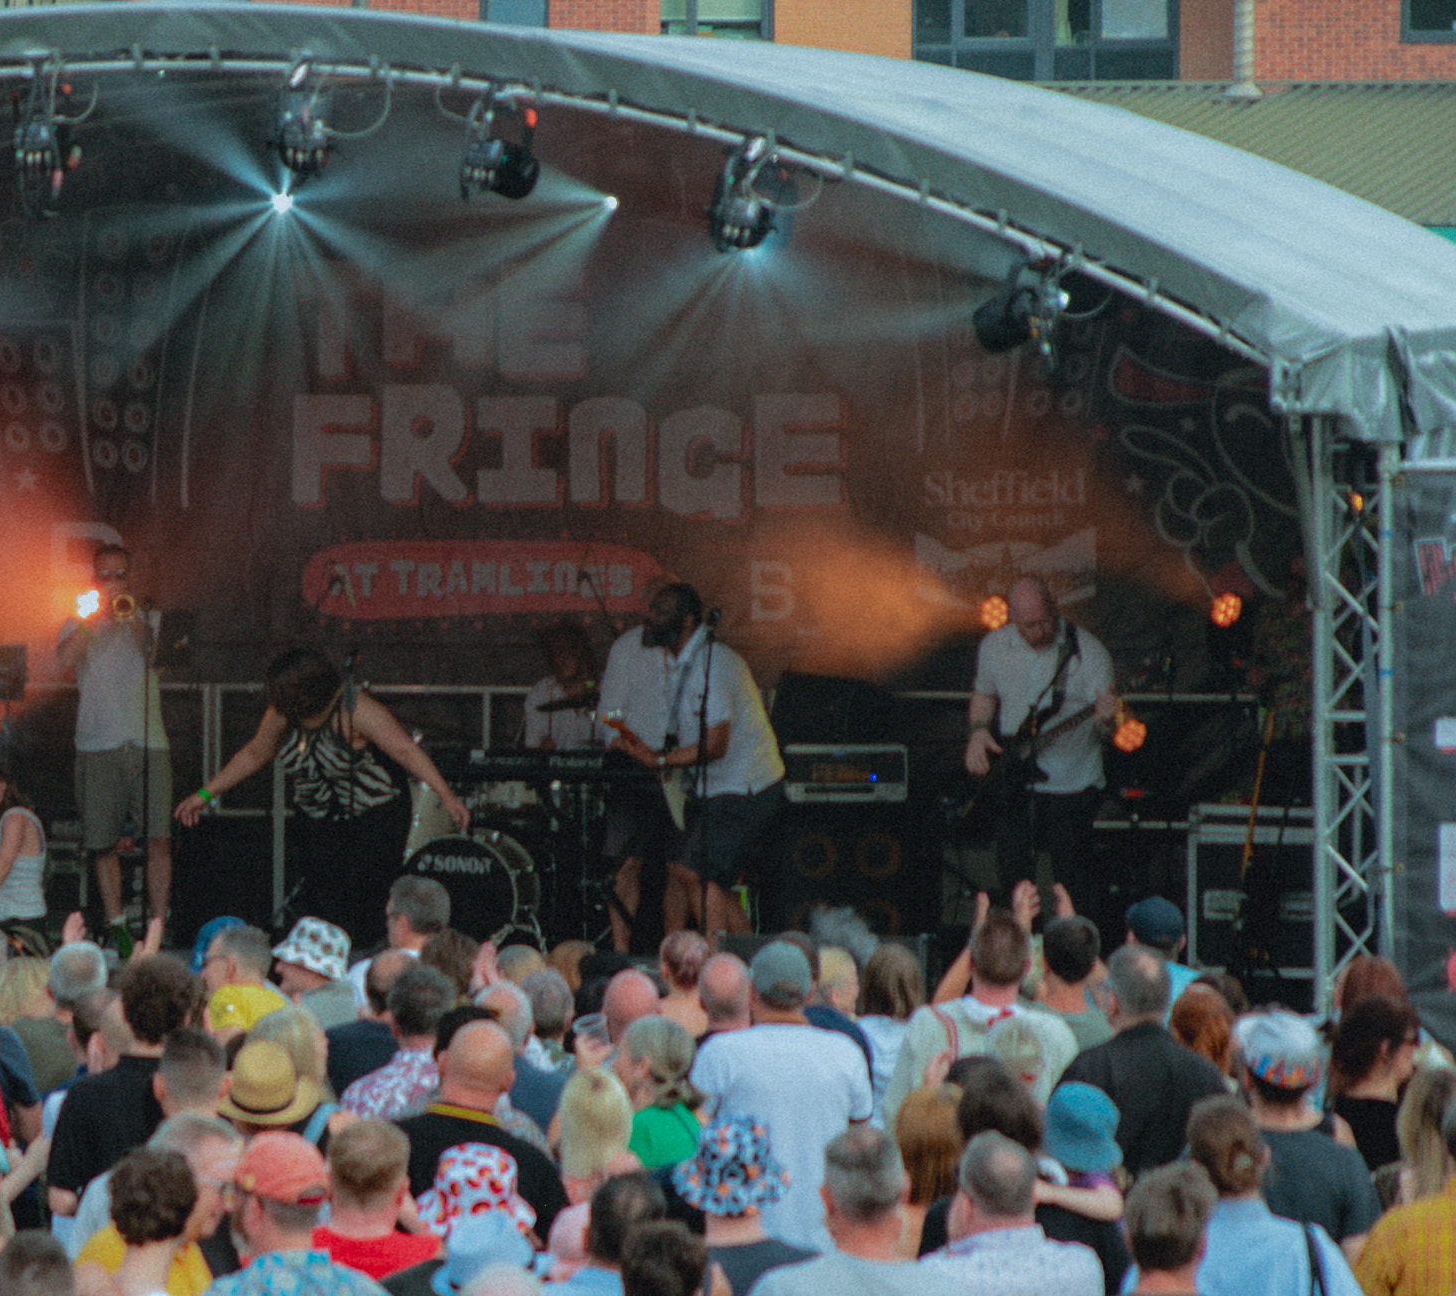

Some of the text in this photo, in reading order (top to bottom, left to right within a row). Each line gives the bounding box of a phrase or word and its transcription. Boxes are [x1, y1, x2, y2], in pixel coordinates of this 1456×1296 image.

[291, 383, 848, 519] FRINGE
[924, 466, 1086, 505] Sheffield
[946, 508, 1065, 532] City Council
[332, 559, 634, 598] AT TRAMLINES
